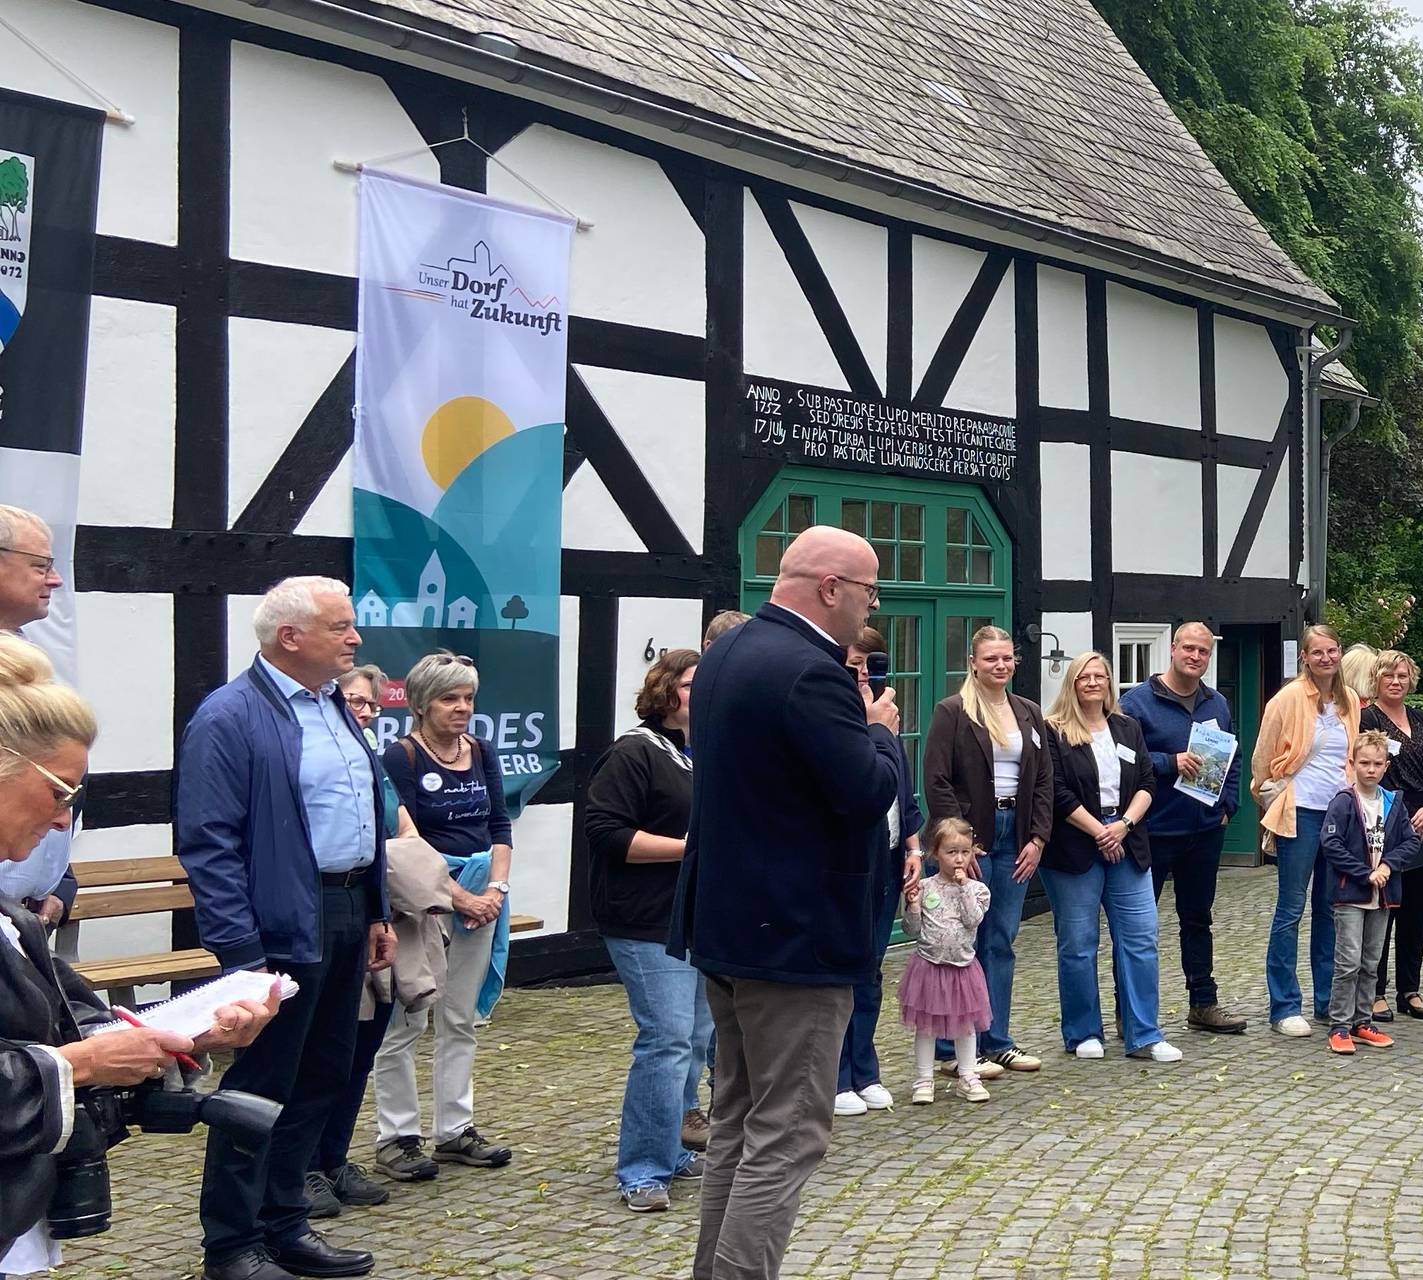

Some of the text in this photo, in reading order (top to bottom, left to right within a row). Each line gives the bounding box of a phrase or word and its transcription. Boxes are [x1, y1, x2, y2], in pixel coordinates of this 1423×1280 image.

[419, 270, 507, 303] Unser Dorf
[451, 295, 562, 336] hat Zukunft
[746, 384, 781, 401] ANNO
[810, 409, 830, 424] SED
[879, 404, 909, 422] LUPO
[804, 440, 827, 457] PRO
[833, 445, 876, 464] PASTORE
[897, 440, 933, 457] VERBIS
